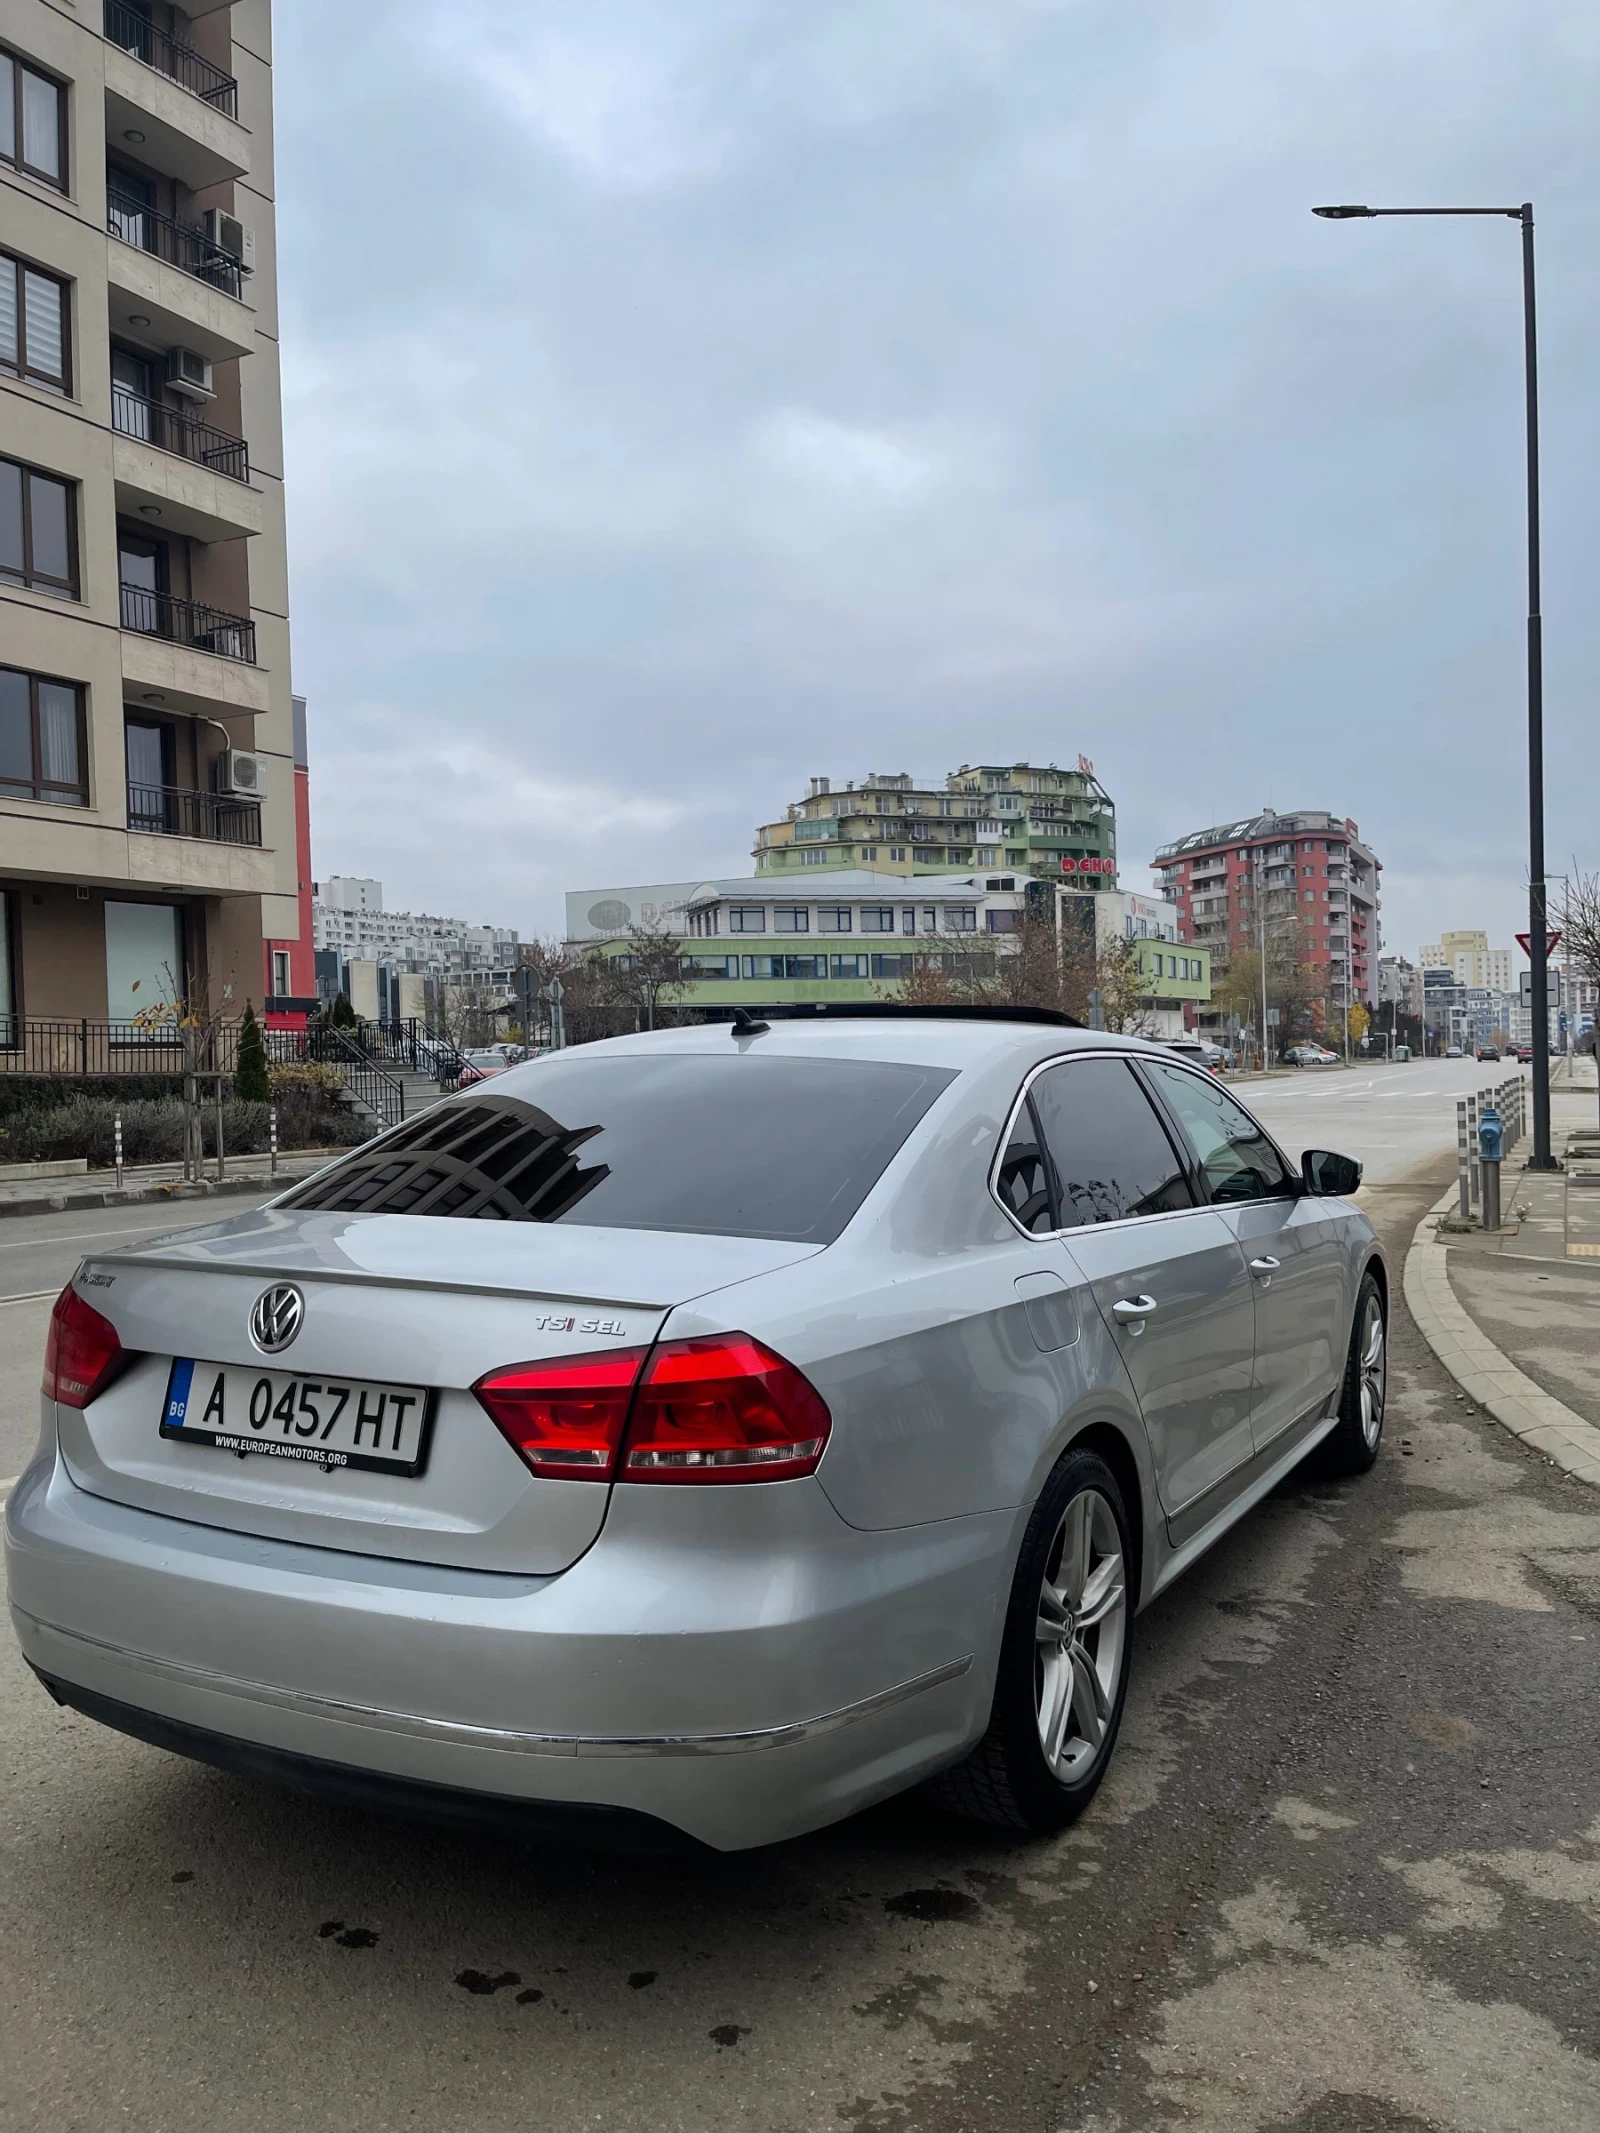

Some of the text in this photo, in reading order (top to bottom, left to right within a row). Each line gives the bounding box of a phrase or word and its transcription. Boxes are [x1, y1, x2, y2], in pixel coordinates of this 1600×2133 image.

[580, 1319, 626, 1337] SEL
[169, 1401, 185, 1418] BG
[202, 1372, 226, 1425] A
[215, 1434, 348, 1466] WWW.EUROPEANMOTORS.ORG
